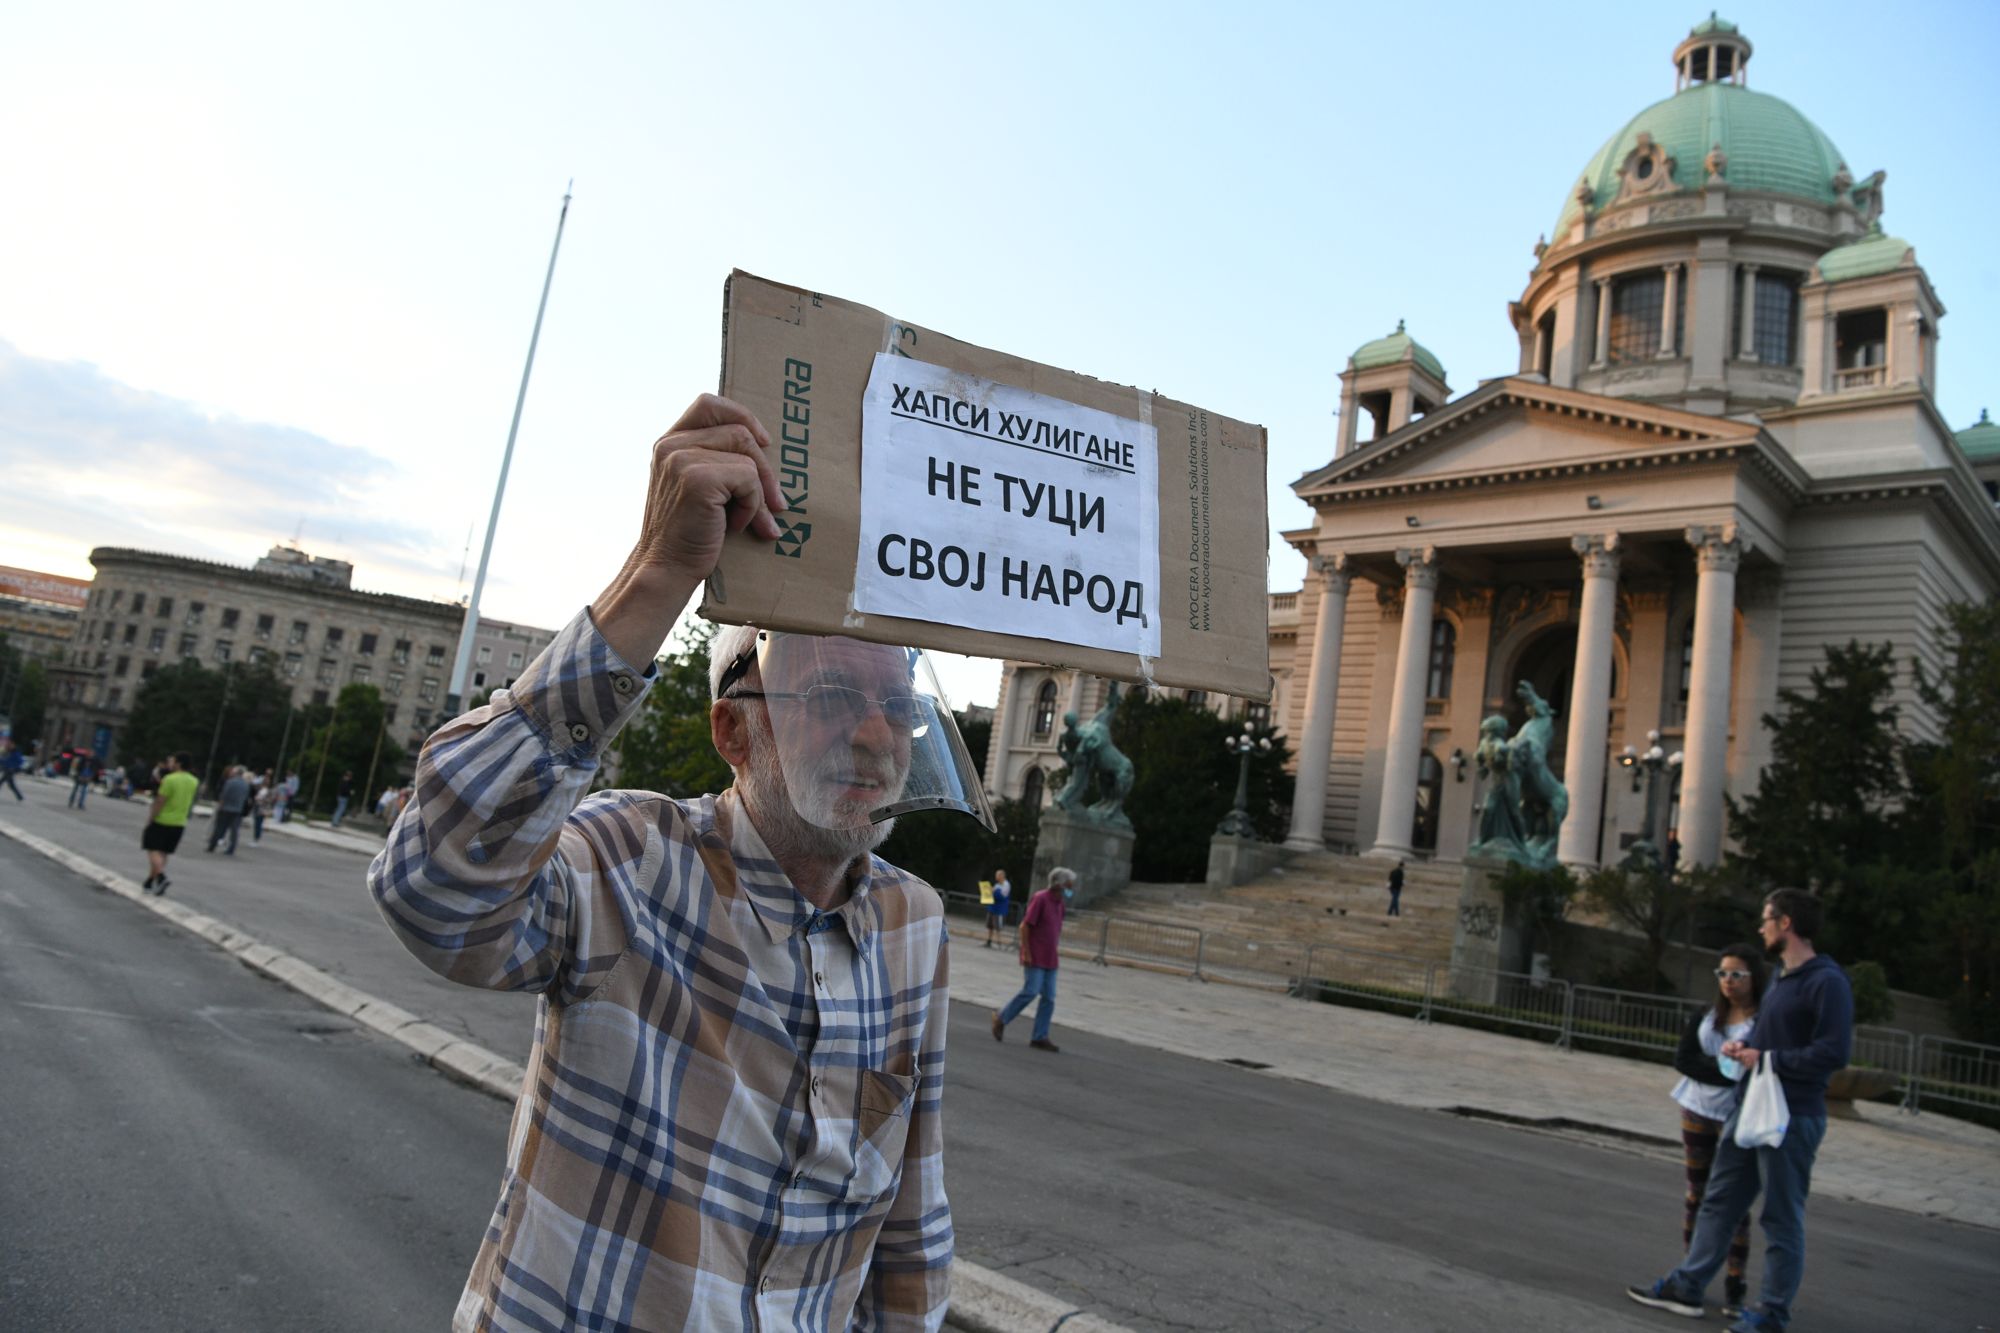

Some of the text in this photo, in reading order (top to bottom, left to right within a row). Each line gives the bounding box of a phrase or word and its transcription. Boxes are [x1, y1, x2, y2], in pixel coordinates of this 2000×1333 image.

[892, 383, 1135, 468] ХАПСИ ХУЛИГАНЕ
[1188, 435, 1199, 492] Solutions
[928, 456, 1105, 537] НЕ ТУЦИ
[1190, 495, 1200, 563] Document
[1201, 412, 1212, 632] www.kyoceradocumentsolutions.com
[877, 533, 1148, 629] СВОЈ НАРОД
[1190, 566, 1200, 631] KYOCERA
